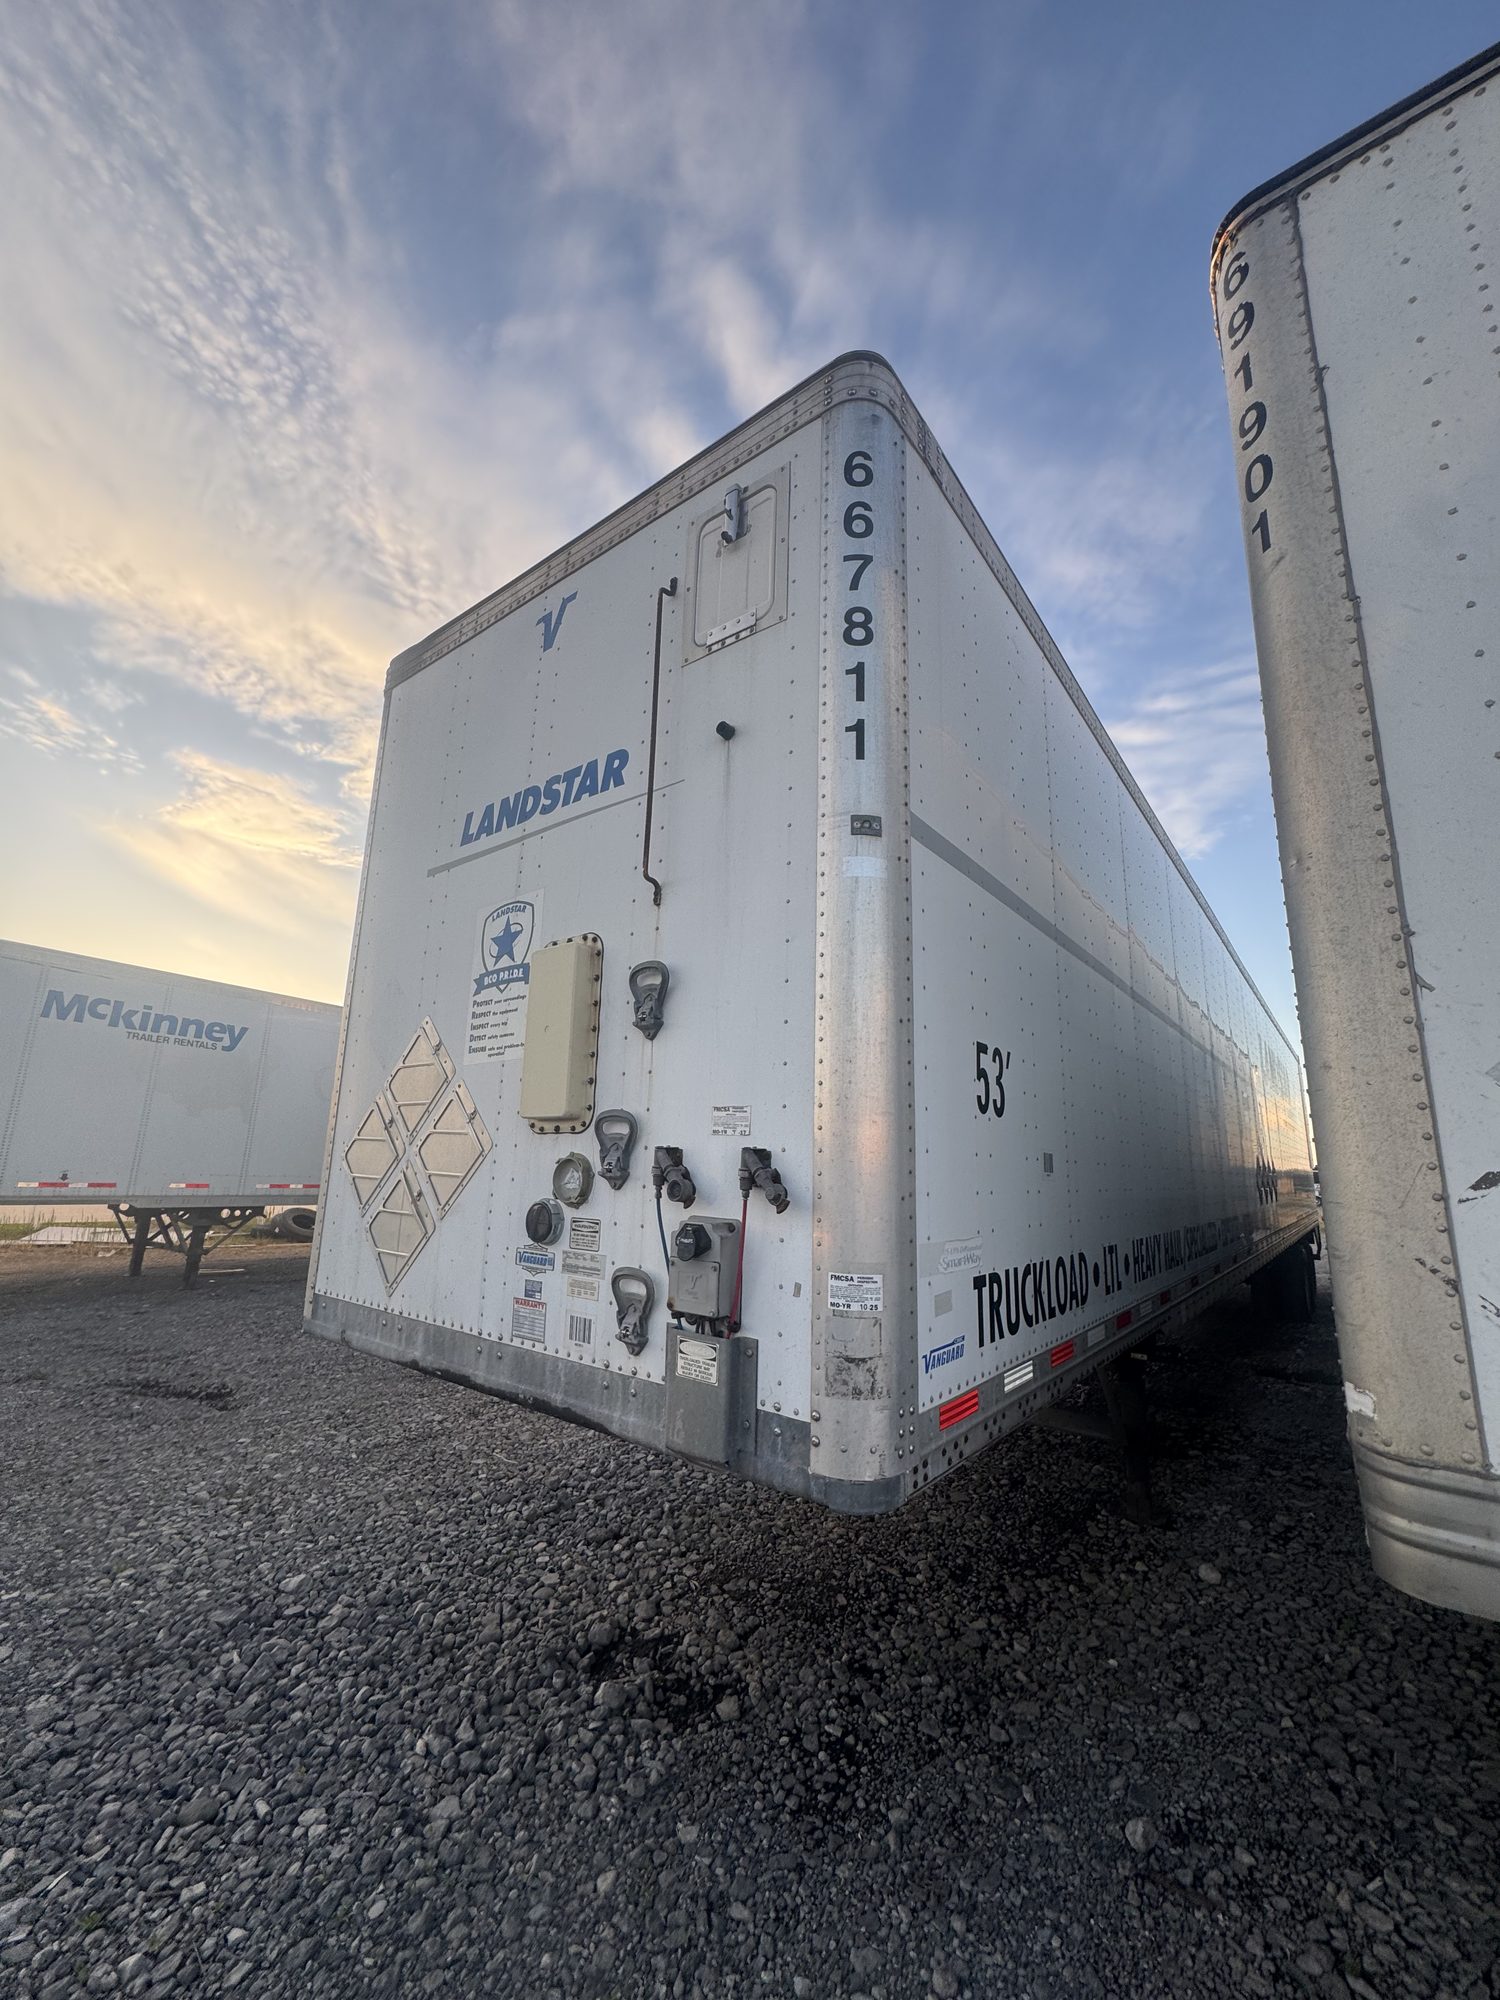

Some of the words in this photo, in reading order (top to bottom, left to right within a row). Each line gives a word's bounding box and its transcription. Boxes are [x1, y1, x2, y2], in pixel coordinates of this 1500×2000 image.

[1224, 251, 1273, 553] 691901
[842, 450, 874, 760] 667811
[460, 749, 630, 847] LANDSTAR
[491, 904, 527, 922] LANDSTAR
[126, 1031, 169, 1044] TRAILER
[174, 1037, 217, 1050] RENTALS
[976, 1040, 1011, 1118] 53'
[830, 1274, 855, 1283] FMCSA
[973, 1251, 1089, 1348] TRUCKLOAD
[1103, 1243, 1123, 1296] LTL
[1132, 1233, 1162, 1284] HEAVY
[515, 1298, 545, 1310] WARRANTY
[830, 1301, 852, 1309] MO-YR
[921, 1343, 965, 1374] VANGUARD
